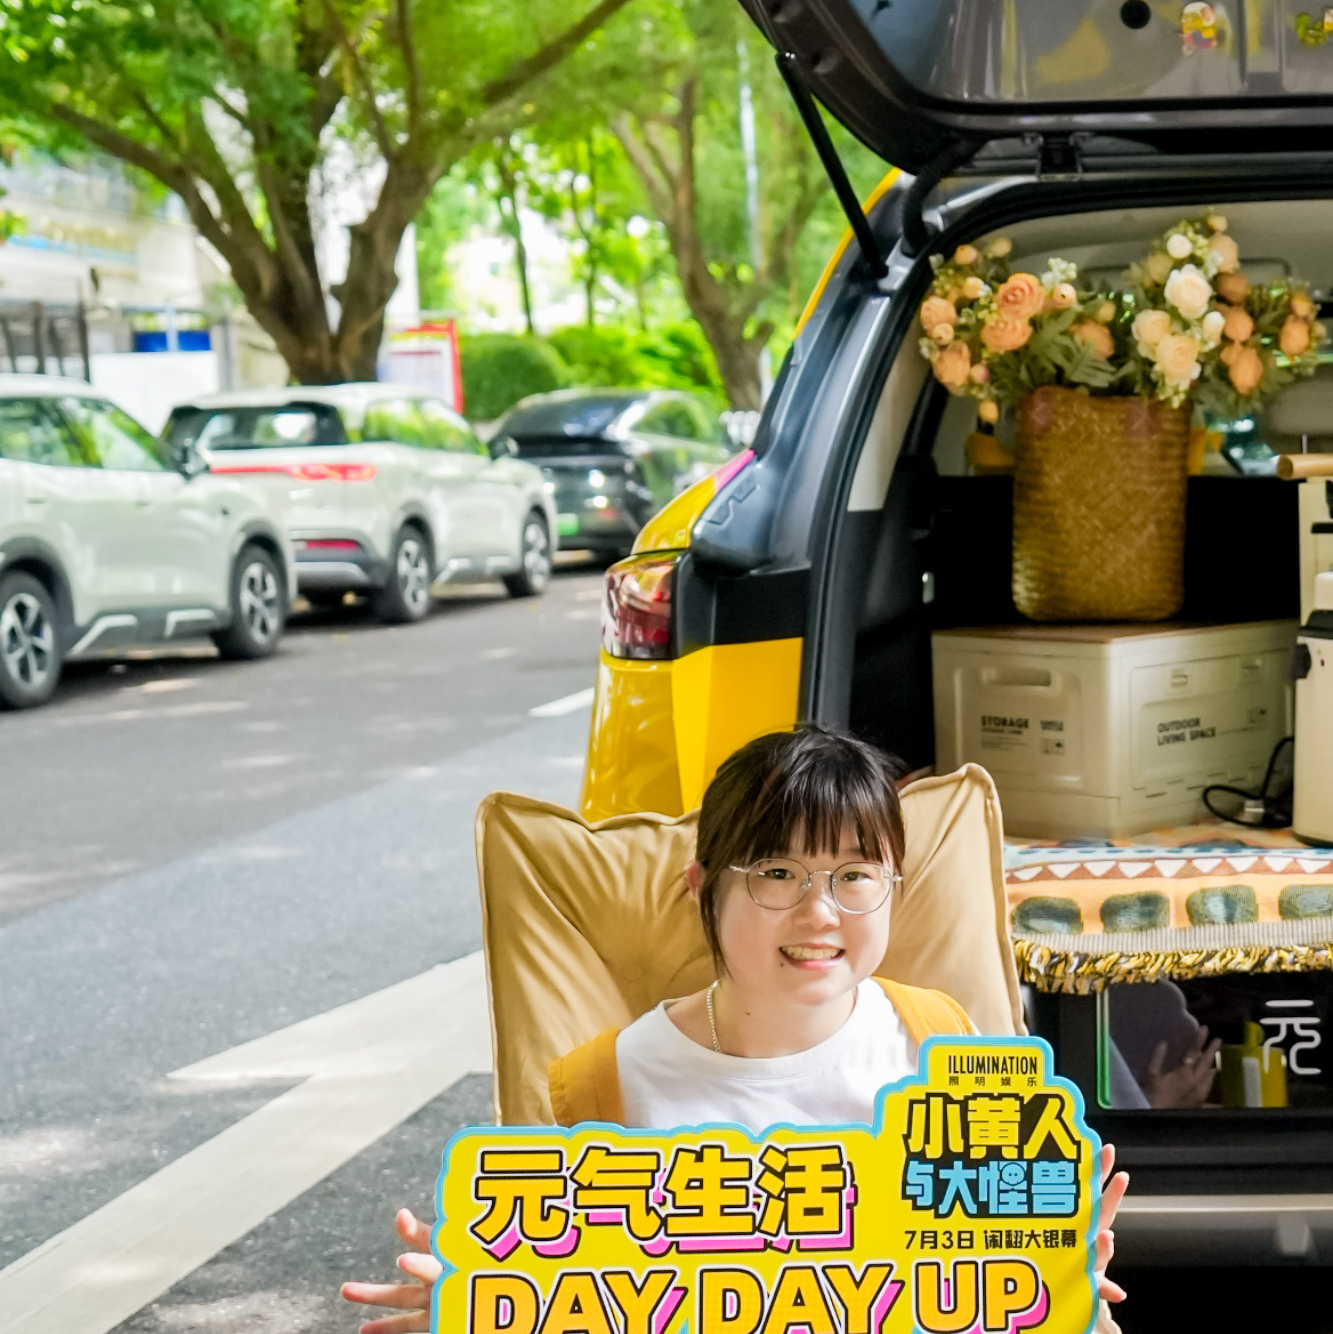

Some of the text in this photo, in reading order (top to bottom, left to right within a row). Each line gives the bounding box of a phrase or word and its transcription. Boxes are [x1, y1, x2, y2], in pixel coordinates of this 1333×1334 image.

[981, 715, 1029, 728] STORAGE
[1157, 717, 1200, 733] OUTDOOR
[1190, 726, 1216, 741] SPACE
[1259, 999, 1322, 1075] 元
[948, 1055, 1038, 1075] ILLUMINATION
[948, 1076, 1038, 1087] 照明娱乐
[907, 1095, 1079, 1160] 小黄人
[905, 1160, 1078, 1215] 与大怪兽
[469, 1145, 852, 1255] 元气生活
[904, 1229, 1077, 1250] 7月3日 闹翻大银幕
